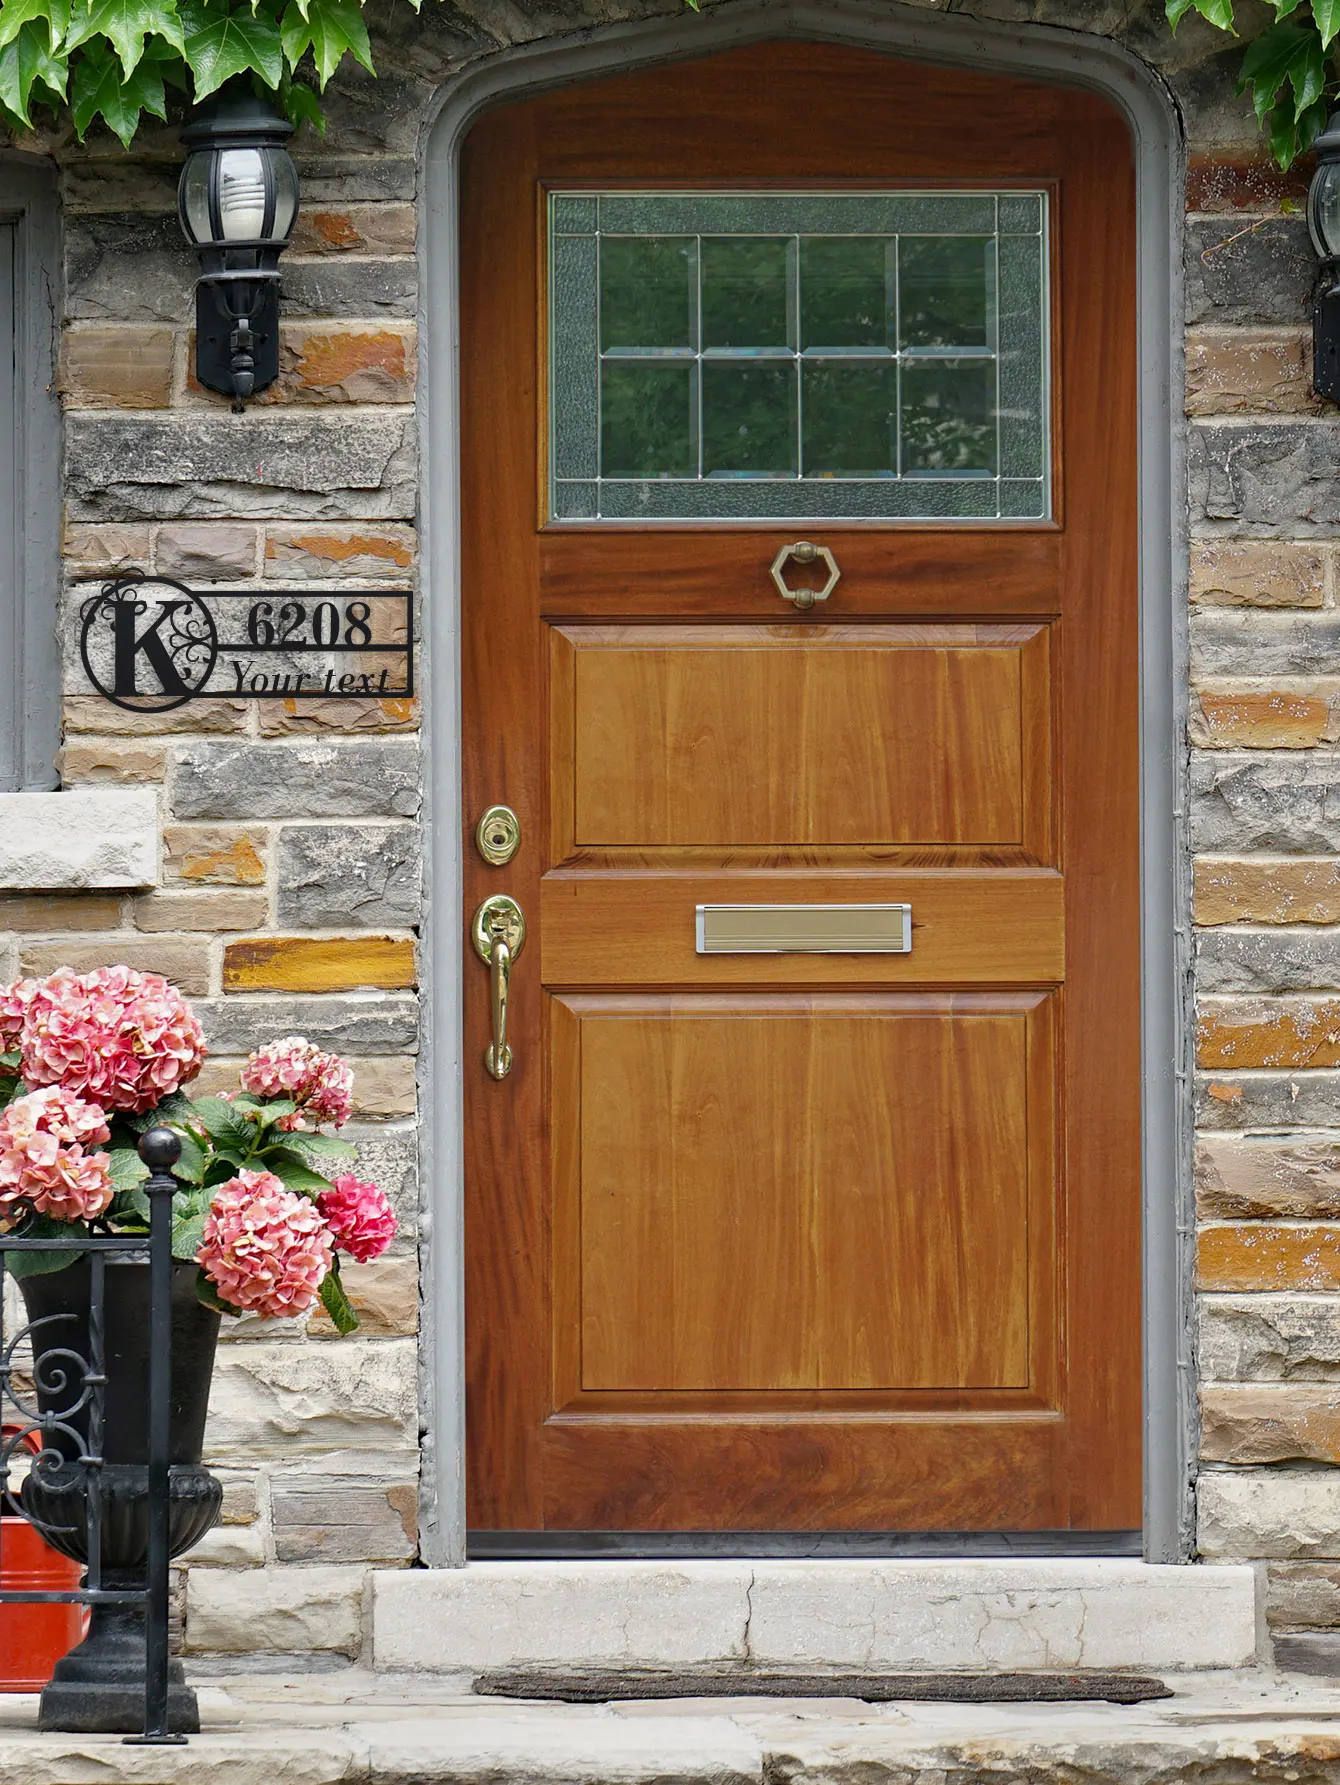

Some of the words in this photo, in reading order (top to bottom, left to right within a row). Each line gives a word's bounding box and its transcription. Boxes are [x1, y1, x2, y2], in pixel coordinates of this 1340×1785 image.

[248, 602, 373, 646] 6208
[104, 600, 194, 696] K
[229, 660, 311, 693] Your
[324, 668, 391, 693] text
